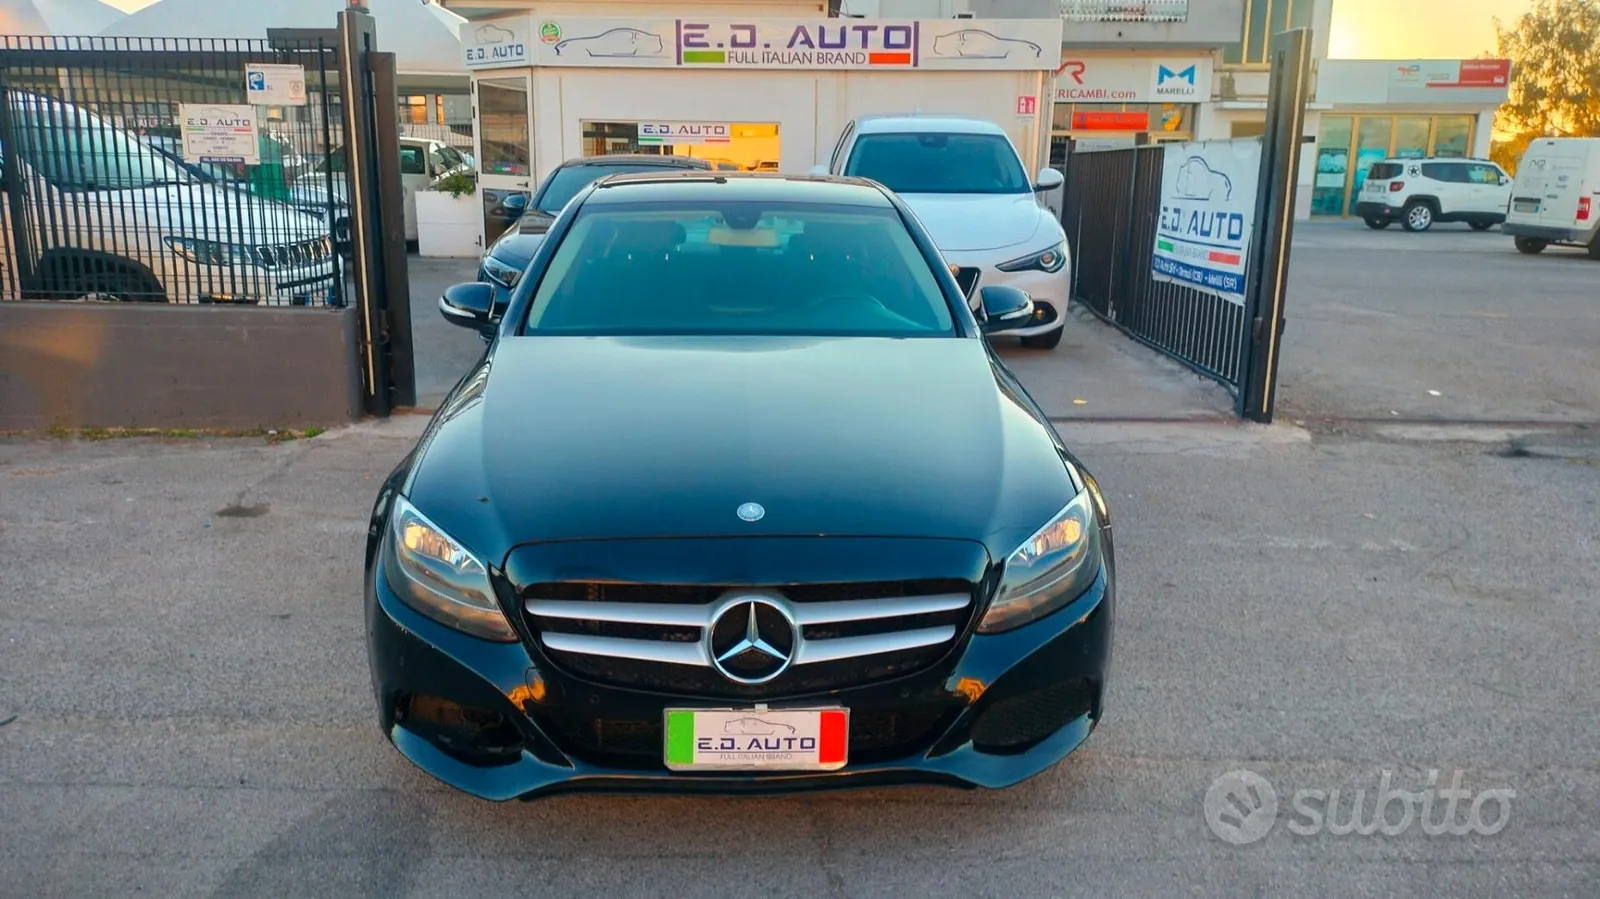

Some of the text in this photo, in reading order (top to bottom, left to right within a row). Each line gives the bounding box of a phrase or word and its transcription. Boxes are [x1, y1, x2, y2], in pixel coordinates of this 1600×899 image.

[683, 23, 913, 50] E.D. AUTO
[492, 44, 524, 58] AUTO
[728, 51, 867, 65] FULL ITALIAN BRAND
[1156, 88, 1194, 96] MARELLI
[217, 119, 251, 127] AUTO
[679, 125, 725, 135] AUTO
[1187, 210, 1243, 240] AUTO
[698, 737, 816, 750] E.D. AUTO
